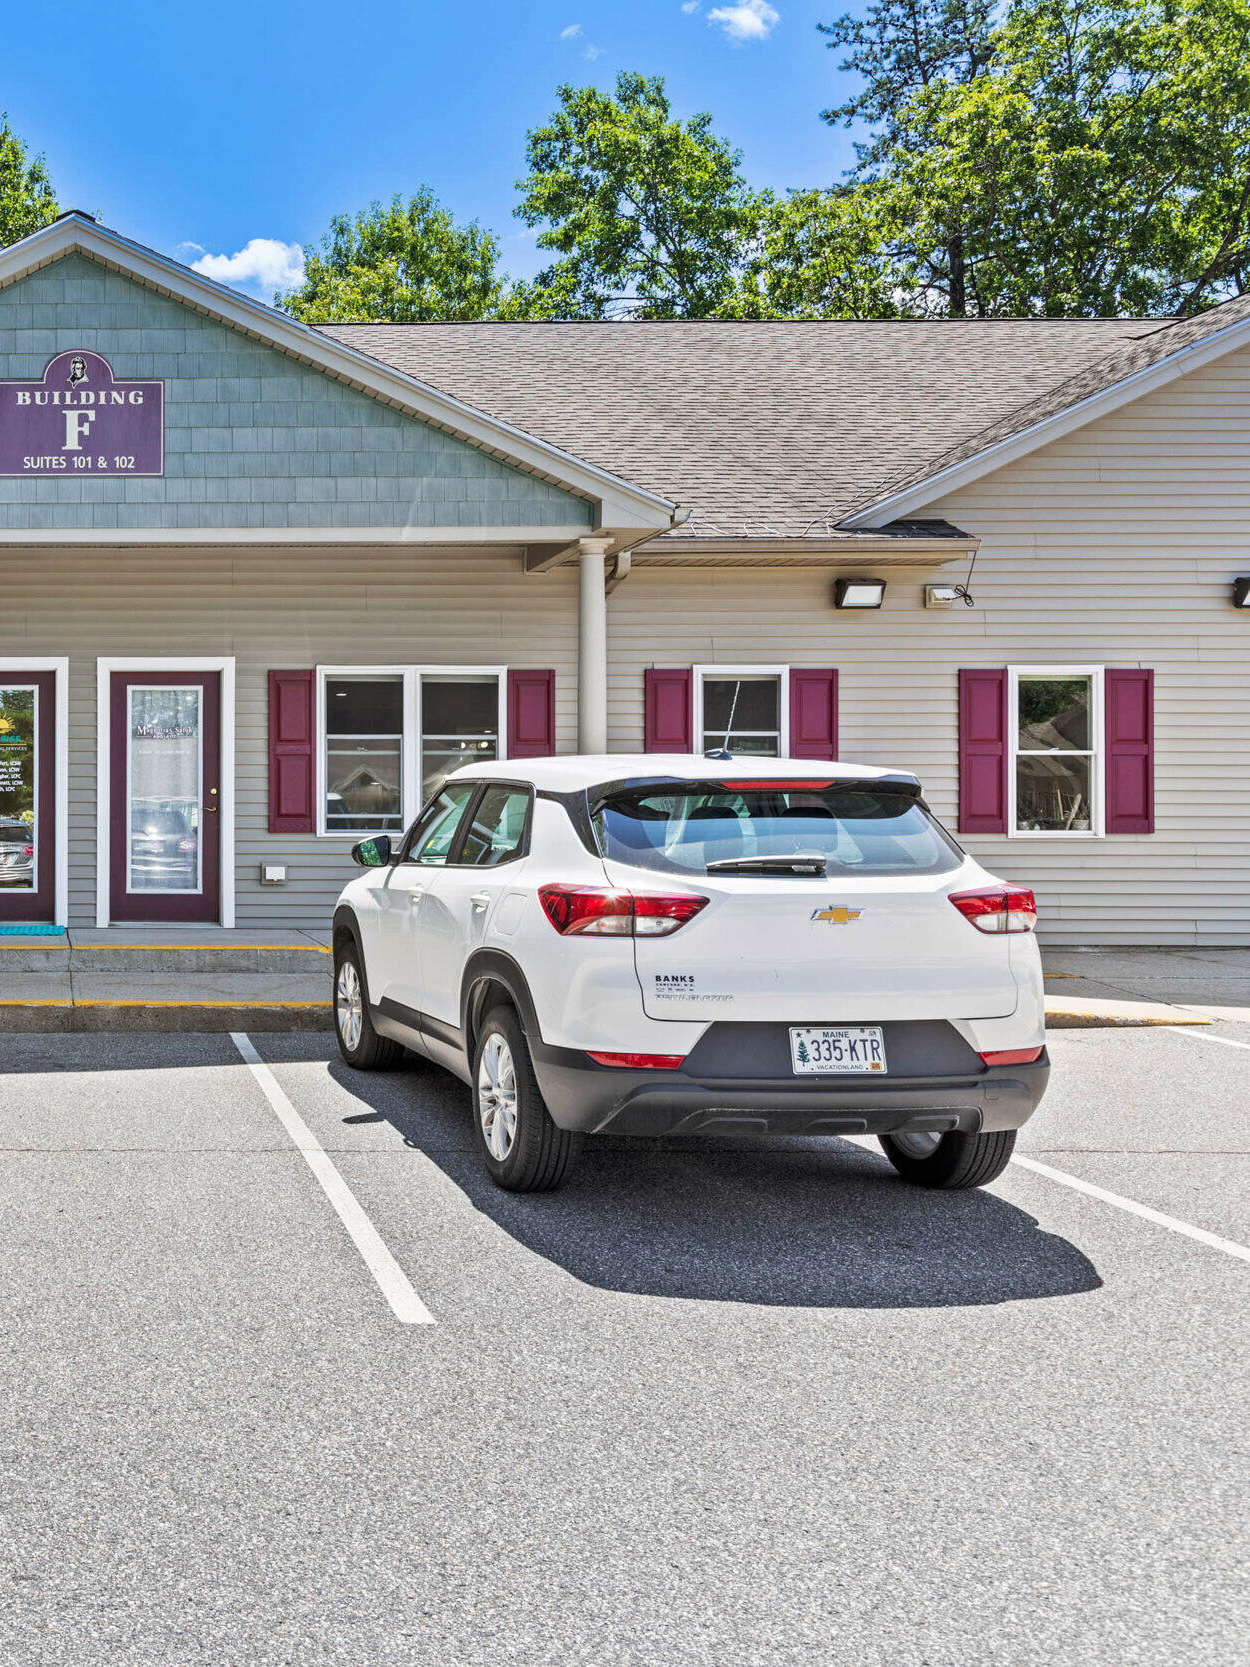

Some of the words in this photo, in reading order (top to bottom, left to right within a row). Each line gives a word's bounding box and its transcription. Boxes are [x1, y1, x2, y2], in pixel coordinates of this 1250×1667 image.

[15, 390, 144, 406] BUILDING
[61, 409, 96, 451] F
[23, 456, 67, 469] SUITES
[72, 456, 92, 469] 101
[97, 456, 108, 469] &
[113, 456, 135, 469] 102
[655, 975, 695, 983] BANKS
